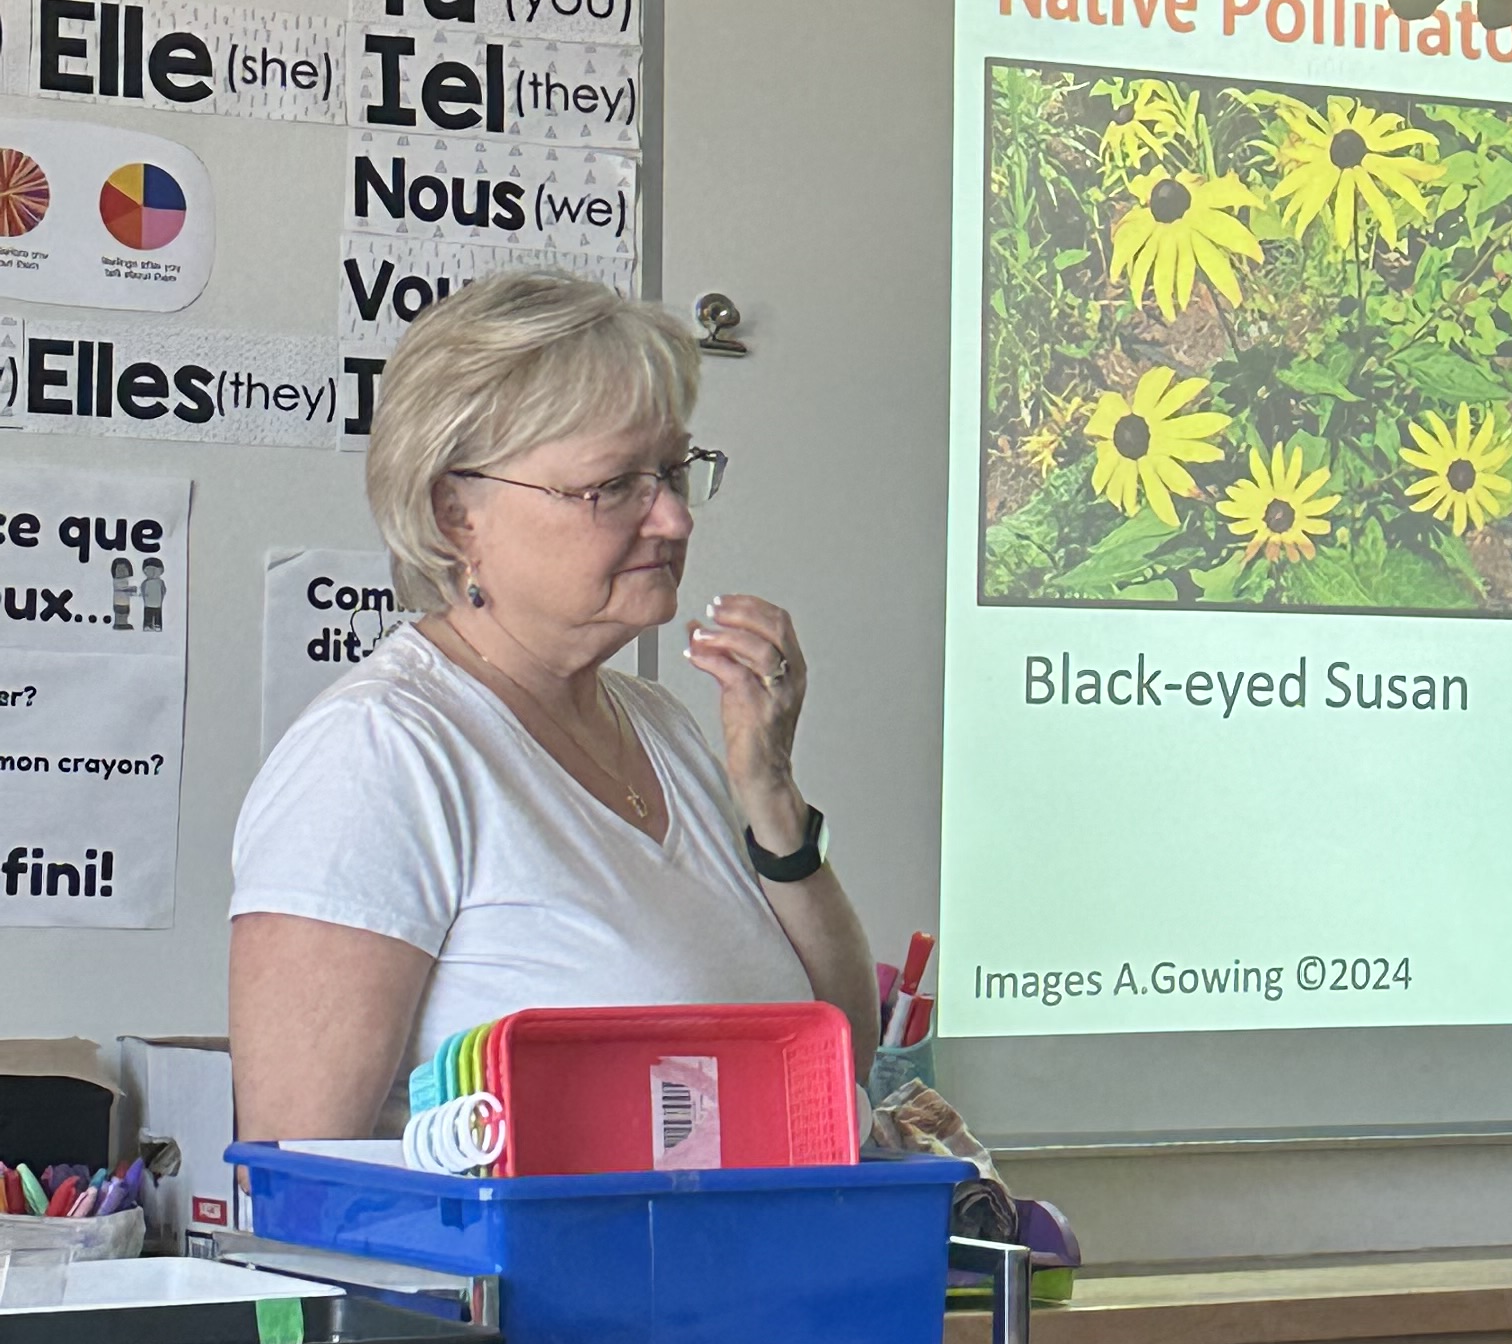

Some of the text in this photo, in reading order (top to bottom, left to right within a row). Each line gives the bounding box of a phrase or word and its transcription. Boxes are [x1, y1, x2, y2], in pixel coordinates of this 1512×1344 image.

[228, 43, 331, 101] (she)
[364, 34, 635, 133] Iel (they)
[354, 156, 626, 237] Nous (we)
[27, 338, 215, 423] Elles
[217, 369, 336, 423] (they)
[58, 516, 163, 563] que
[0, 587, 112, 624] ux...
[1024, 652, 1470, 719] Black-eyed Susan
[58, 754, 164, 780] crayon?
[2, 847, 114, 898] fini!
[974, 956, 1413, 1006] Images A.Gowing ©2024
